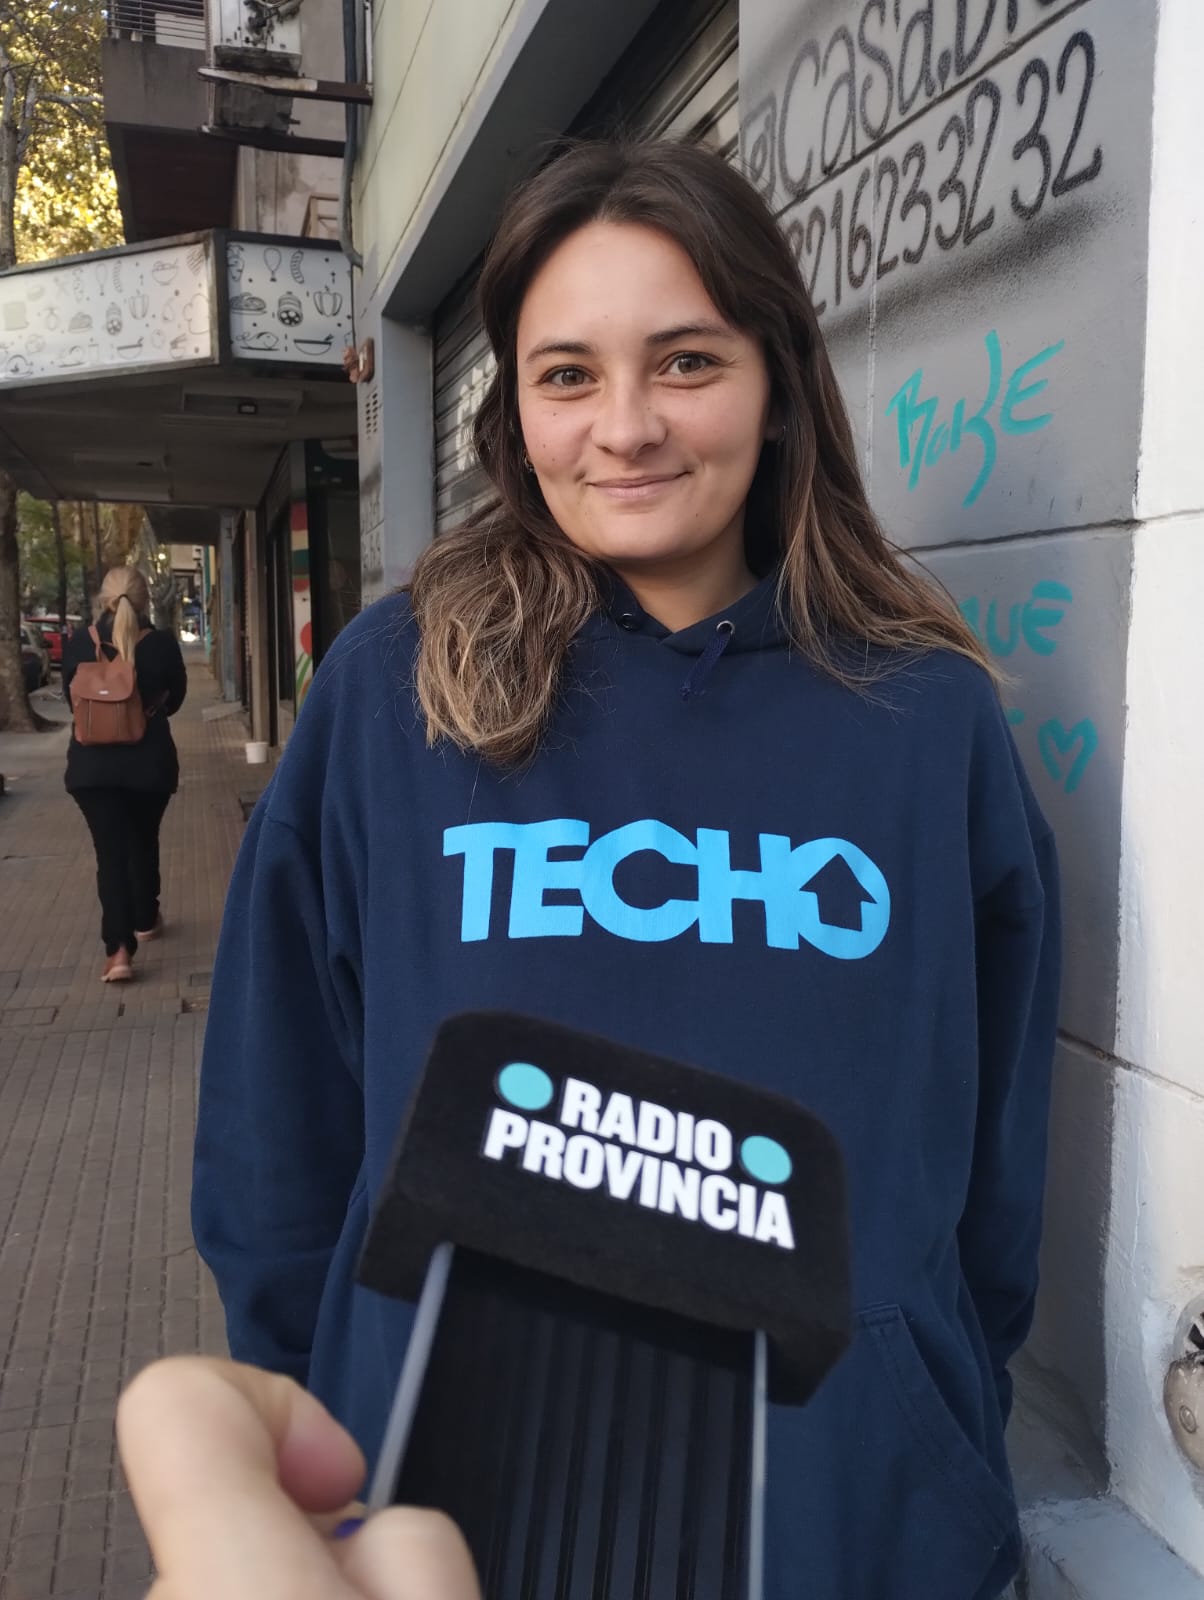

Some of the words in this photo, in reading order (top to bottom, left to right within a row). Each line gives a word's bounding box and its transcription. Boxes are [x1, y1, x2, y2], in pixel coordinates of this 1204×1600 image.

[443, 818, 890, 960] TECHO
[483, 1108, 795, 1250] PROVINCIA
[560, 1077, 733, 1171] RADIO
